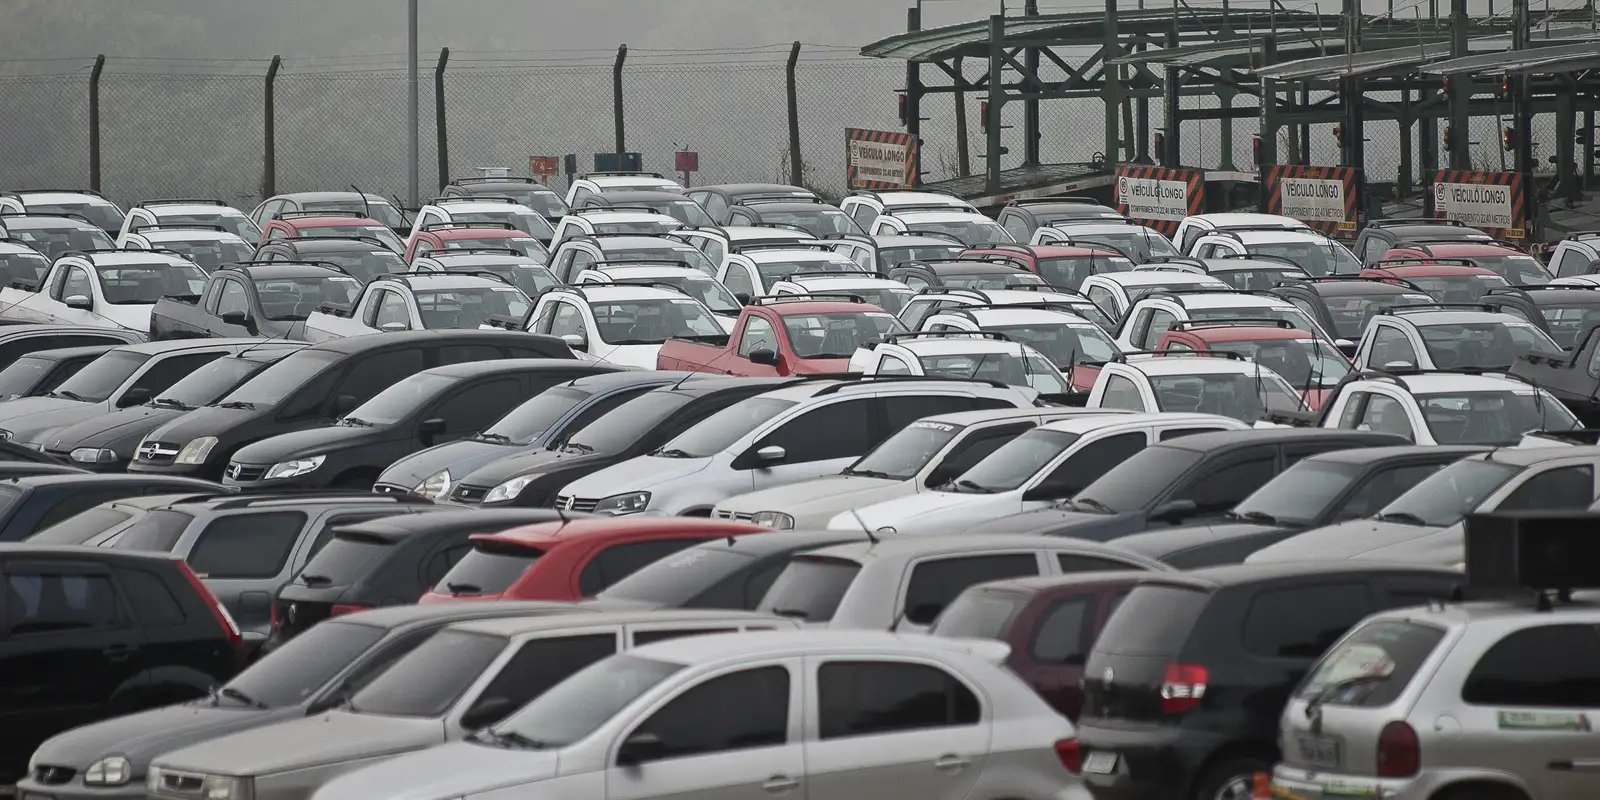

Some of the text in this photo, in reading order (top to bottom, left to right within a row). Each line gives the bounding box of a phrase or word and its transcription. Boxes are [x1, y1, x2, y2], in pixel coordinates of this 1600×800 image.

[884, 149, 904, 162] LONGO
[1131, 184, 1160, 198] VEÍCULO
[1161, 187, 1184, 199] LONGO
[1286, 181, 1338, 198] VEÍCULO LONGO
[1452, 186, 1479, 203] VEÍCULO
[1481, 189, 1505, 204] LONGO
[1131, 204, 1159, 214] COMPRIMENTO
[1170, 207, 1186, 216] METROS
[1284, 206, 1314, 217] COMPRIMENTO
[1326, 208, 1343, 218] METROS
[1492, 214, 1510, 225] METROS
